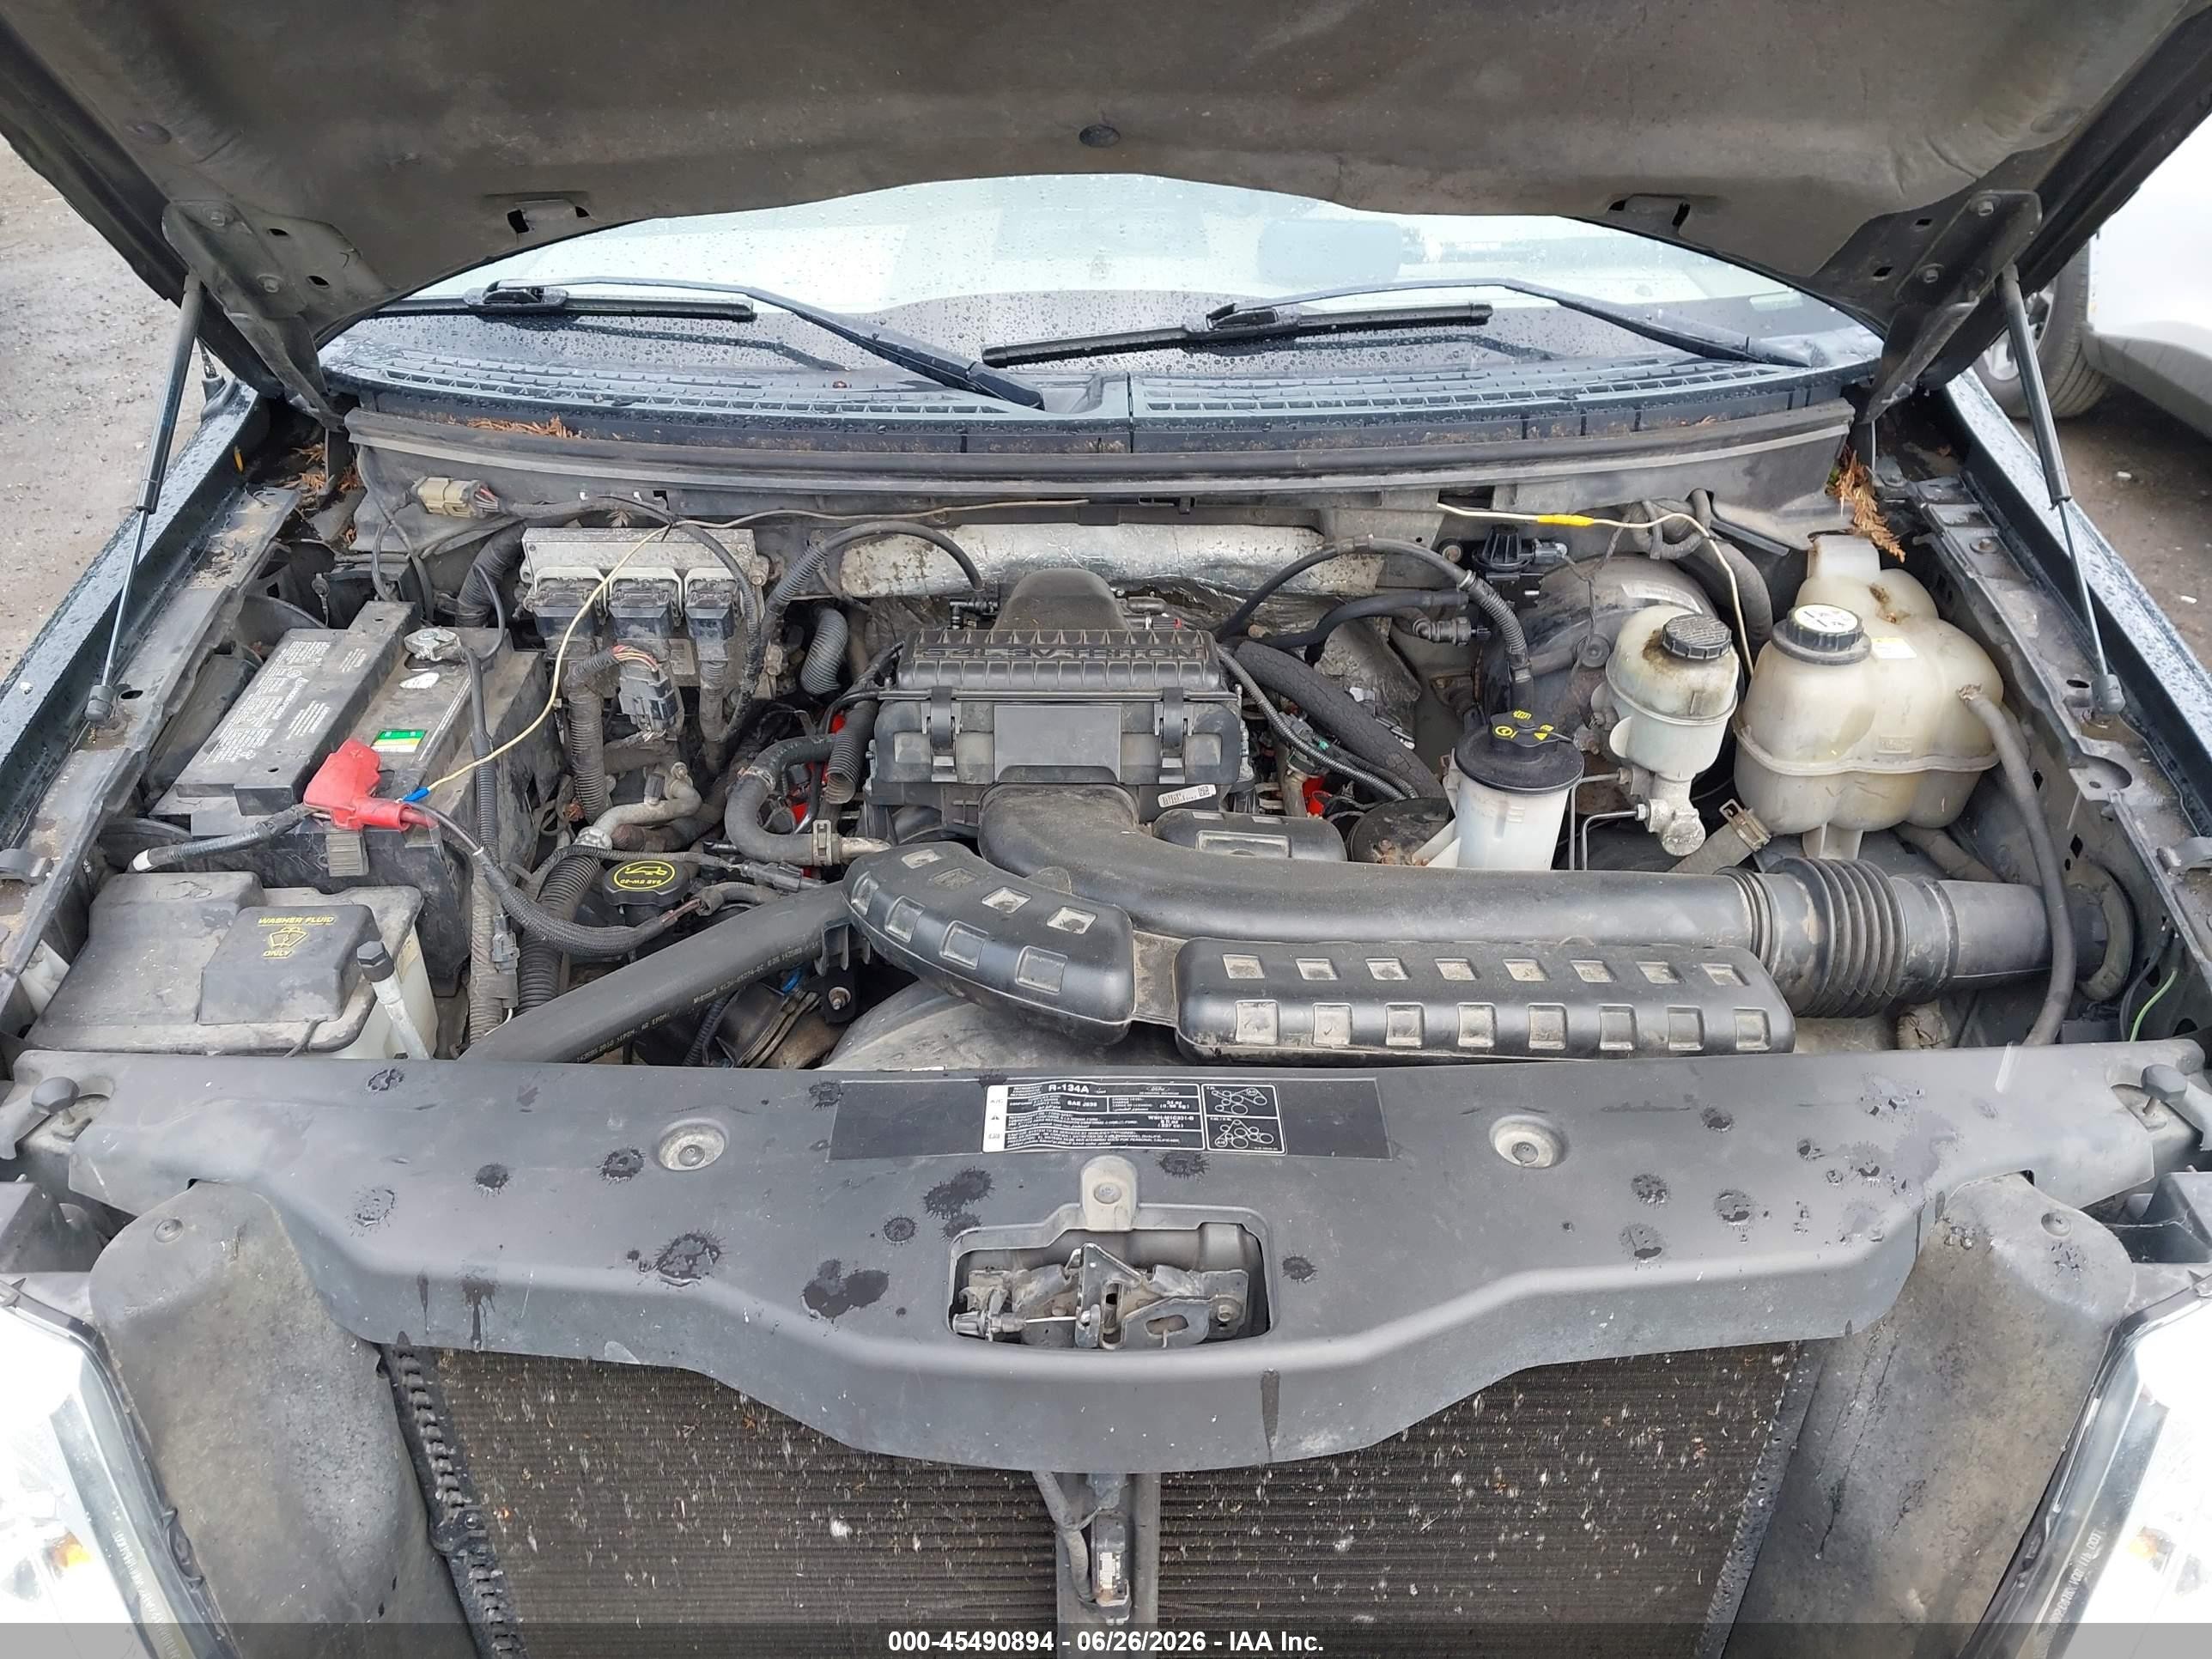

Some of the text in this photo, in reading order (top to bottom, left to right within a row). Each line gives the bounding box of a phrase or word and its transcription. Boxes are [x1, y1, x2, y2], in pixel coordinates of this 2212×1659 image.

[258, 915, 336, 925] WASHER FLUID
[1048, 1083, 1090, 1094] R-134A
